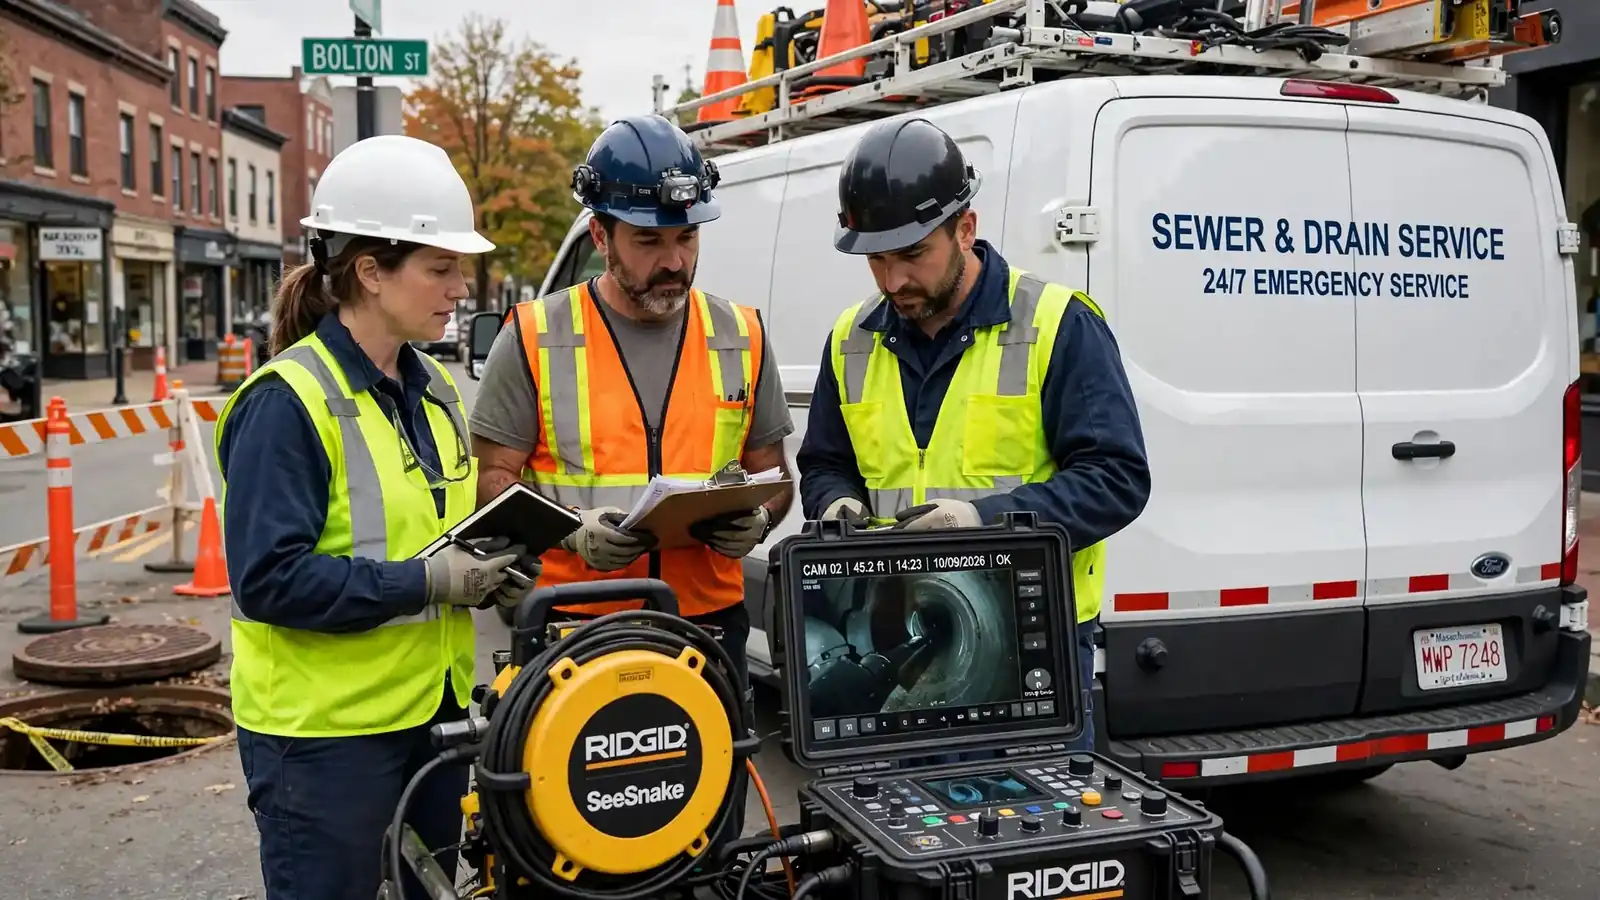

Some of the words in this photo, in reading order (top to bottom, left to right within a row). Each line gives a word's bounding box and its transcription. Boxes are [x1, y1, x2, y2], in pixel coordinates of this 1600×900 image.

[312, 43, 394, 71] BOLTON
[404, 52, 421, 71] ST
[1152, 213, 1266, 253] SEWER
[1275, 218, 1295, 254] &
[1304, 219, 1389, 257] DRAIN
[1398, 223, 1505, 261] SERVICE
[1203, 268, 1247, 295] 24/7
[1254, 269, 1384, 297] EMERGENCY
[1390, 273, 1469, 299] SERVICE
[803, 563, 828, 576] CAM
[830, 562, 843, 575] 02
[853, 561, 875, 574] 45.2
[876, 560, 885, 572] ft
[895, 558, 923, 571] 14:23
[933, 555, 986, 569] 10/09/2026
[996, 553, 1012, 566] OK
[1422, 645, 1453, 674] MWP
[1458, 640, 1500, 670] 7248
[587, 780, 685, 812] SeeSnake
[1007, 859, 1125, 900] RIDGID
